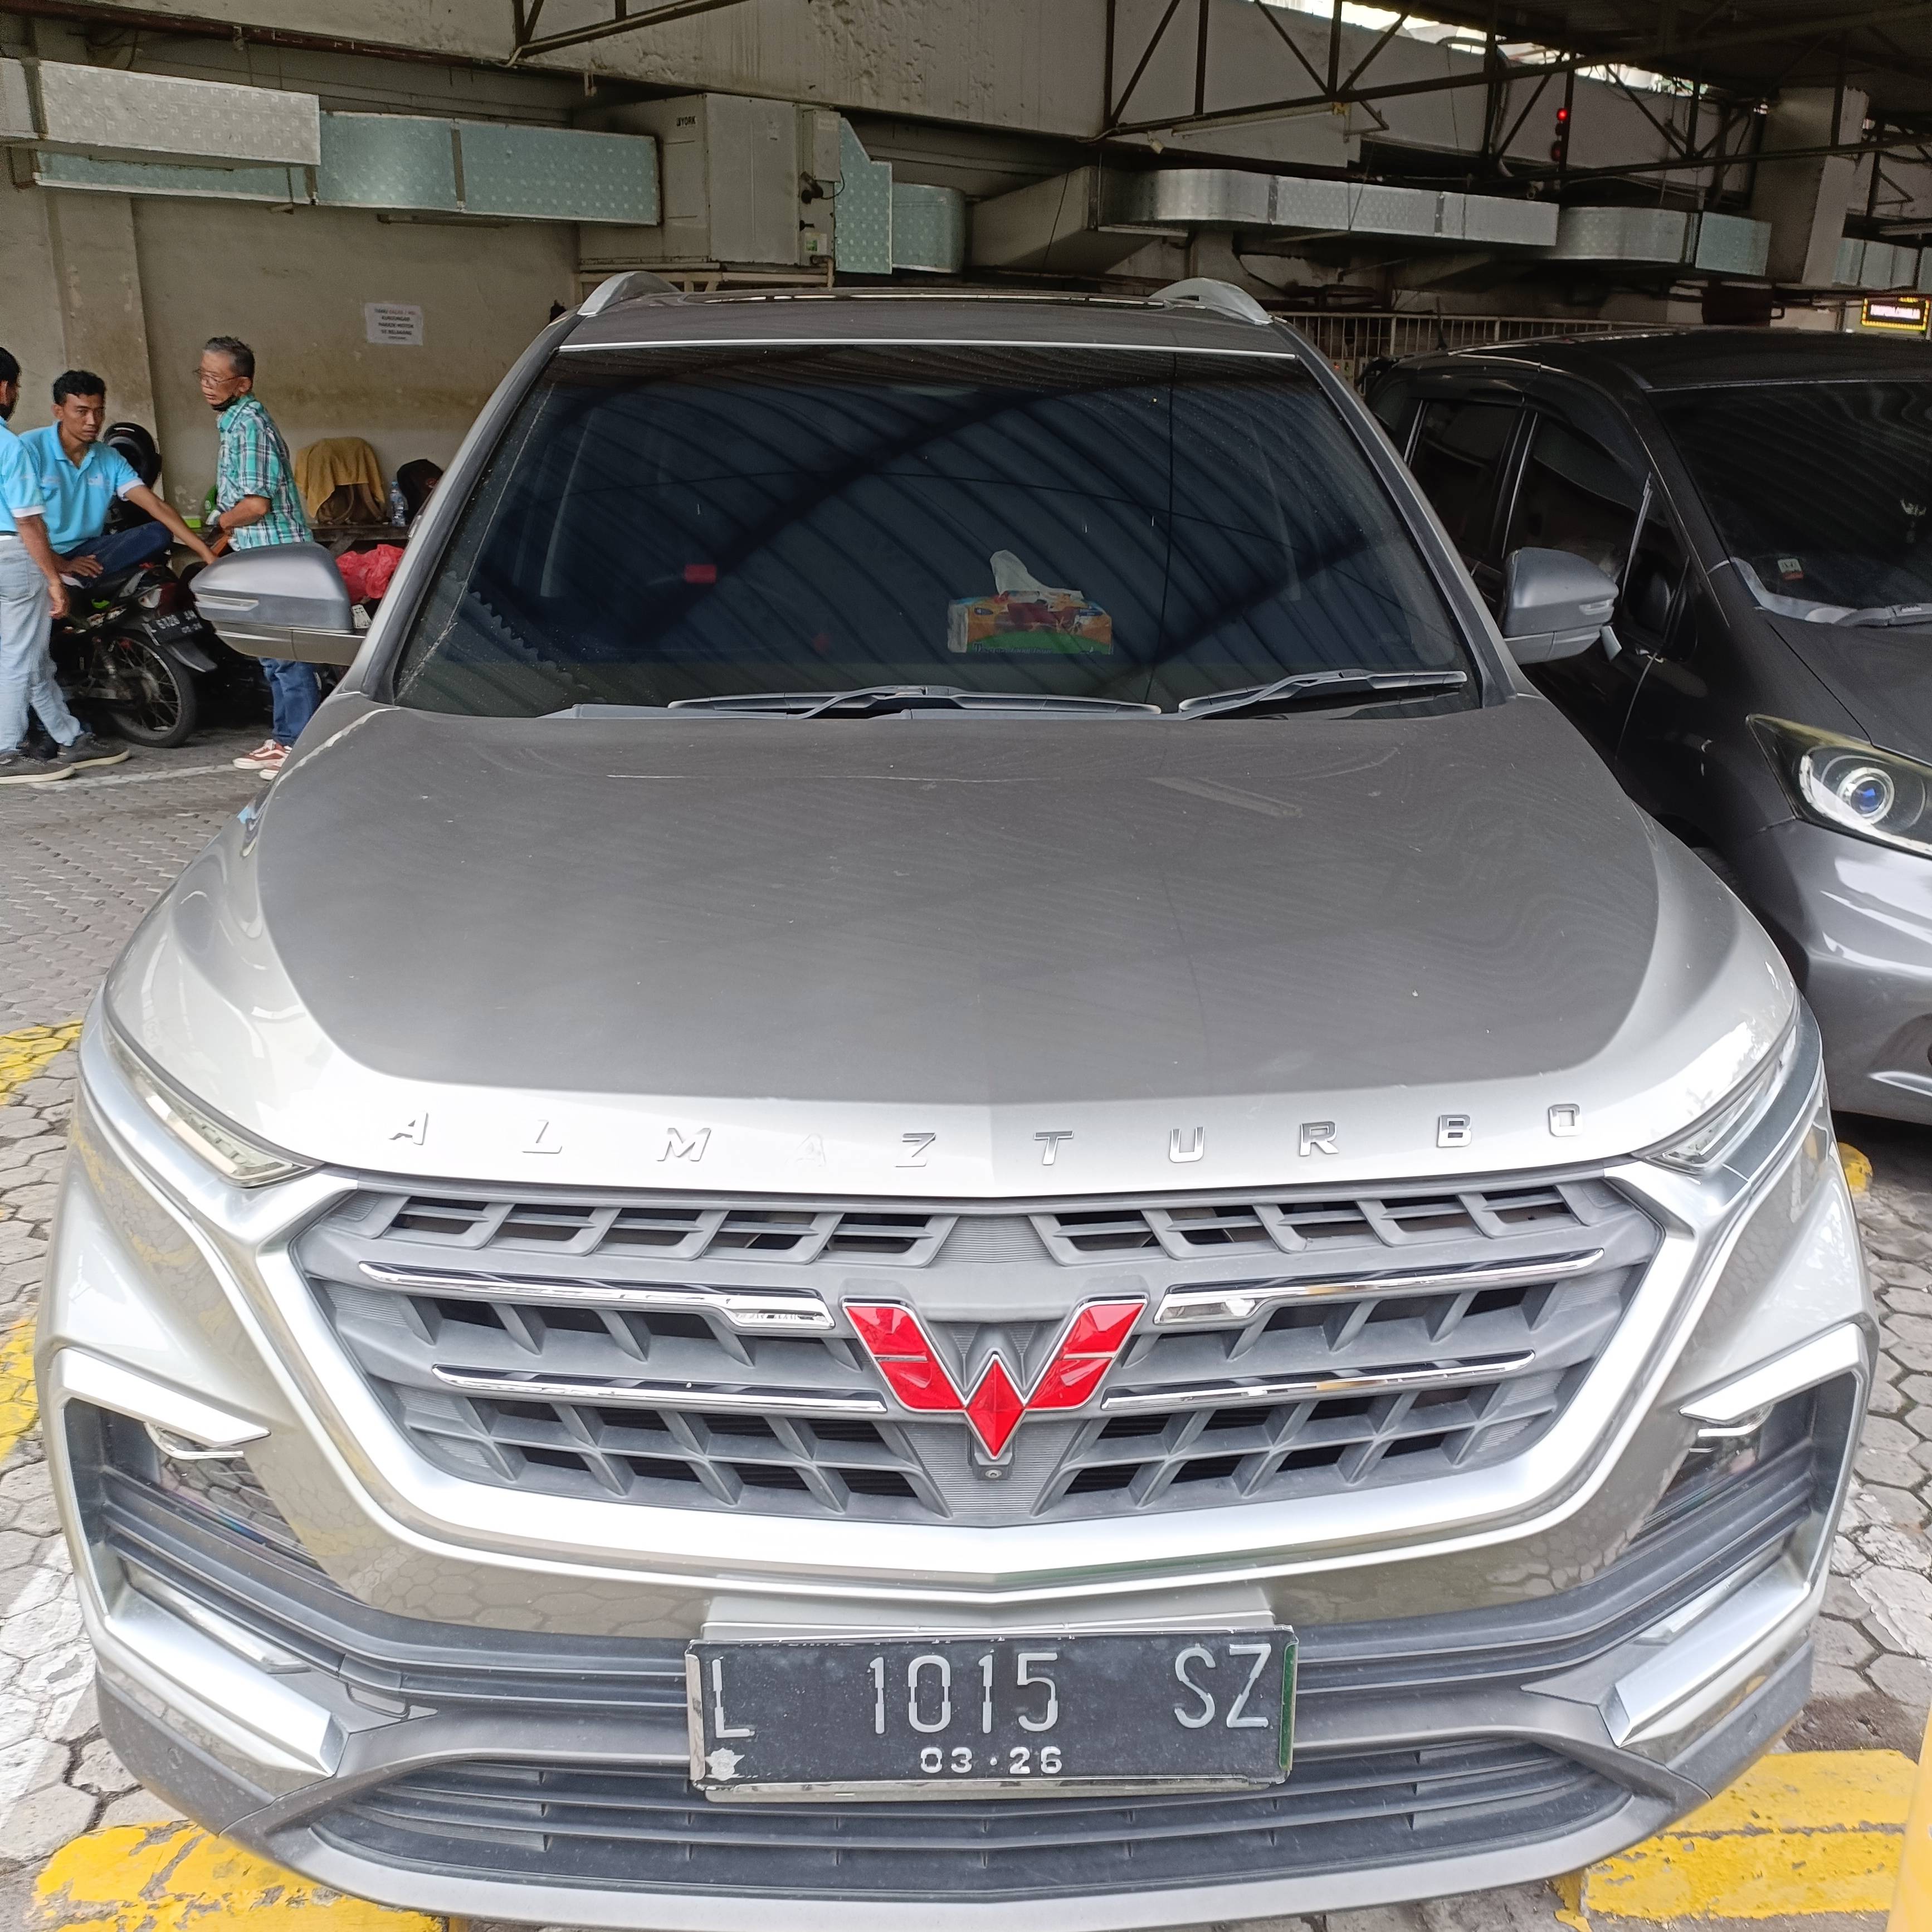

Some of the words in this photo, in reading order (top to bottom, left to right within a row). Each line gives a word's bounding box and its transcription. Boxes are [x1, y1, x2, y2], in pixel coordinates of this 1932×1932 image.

[1033, 1103, 1583, 1166] TURBO
[712, 1658, 755, 1739] L
[869, 1651, 1058, 1735] 1015
[1174, 1642, 1272, 1730] SZ
